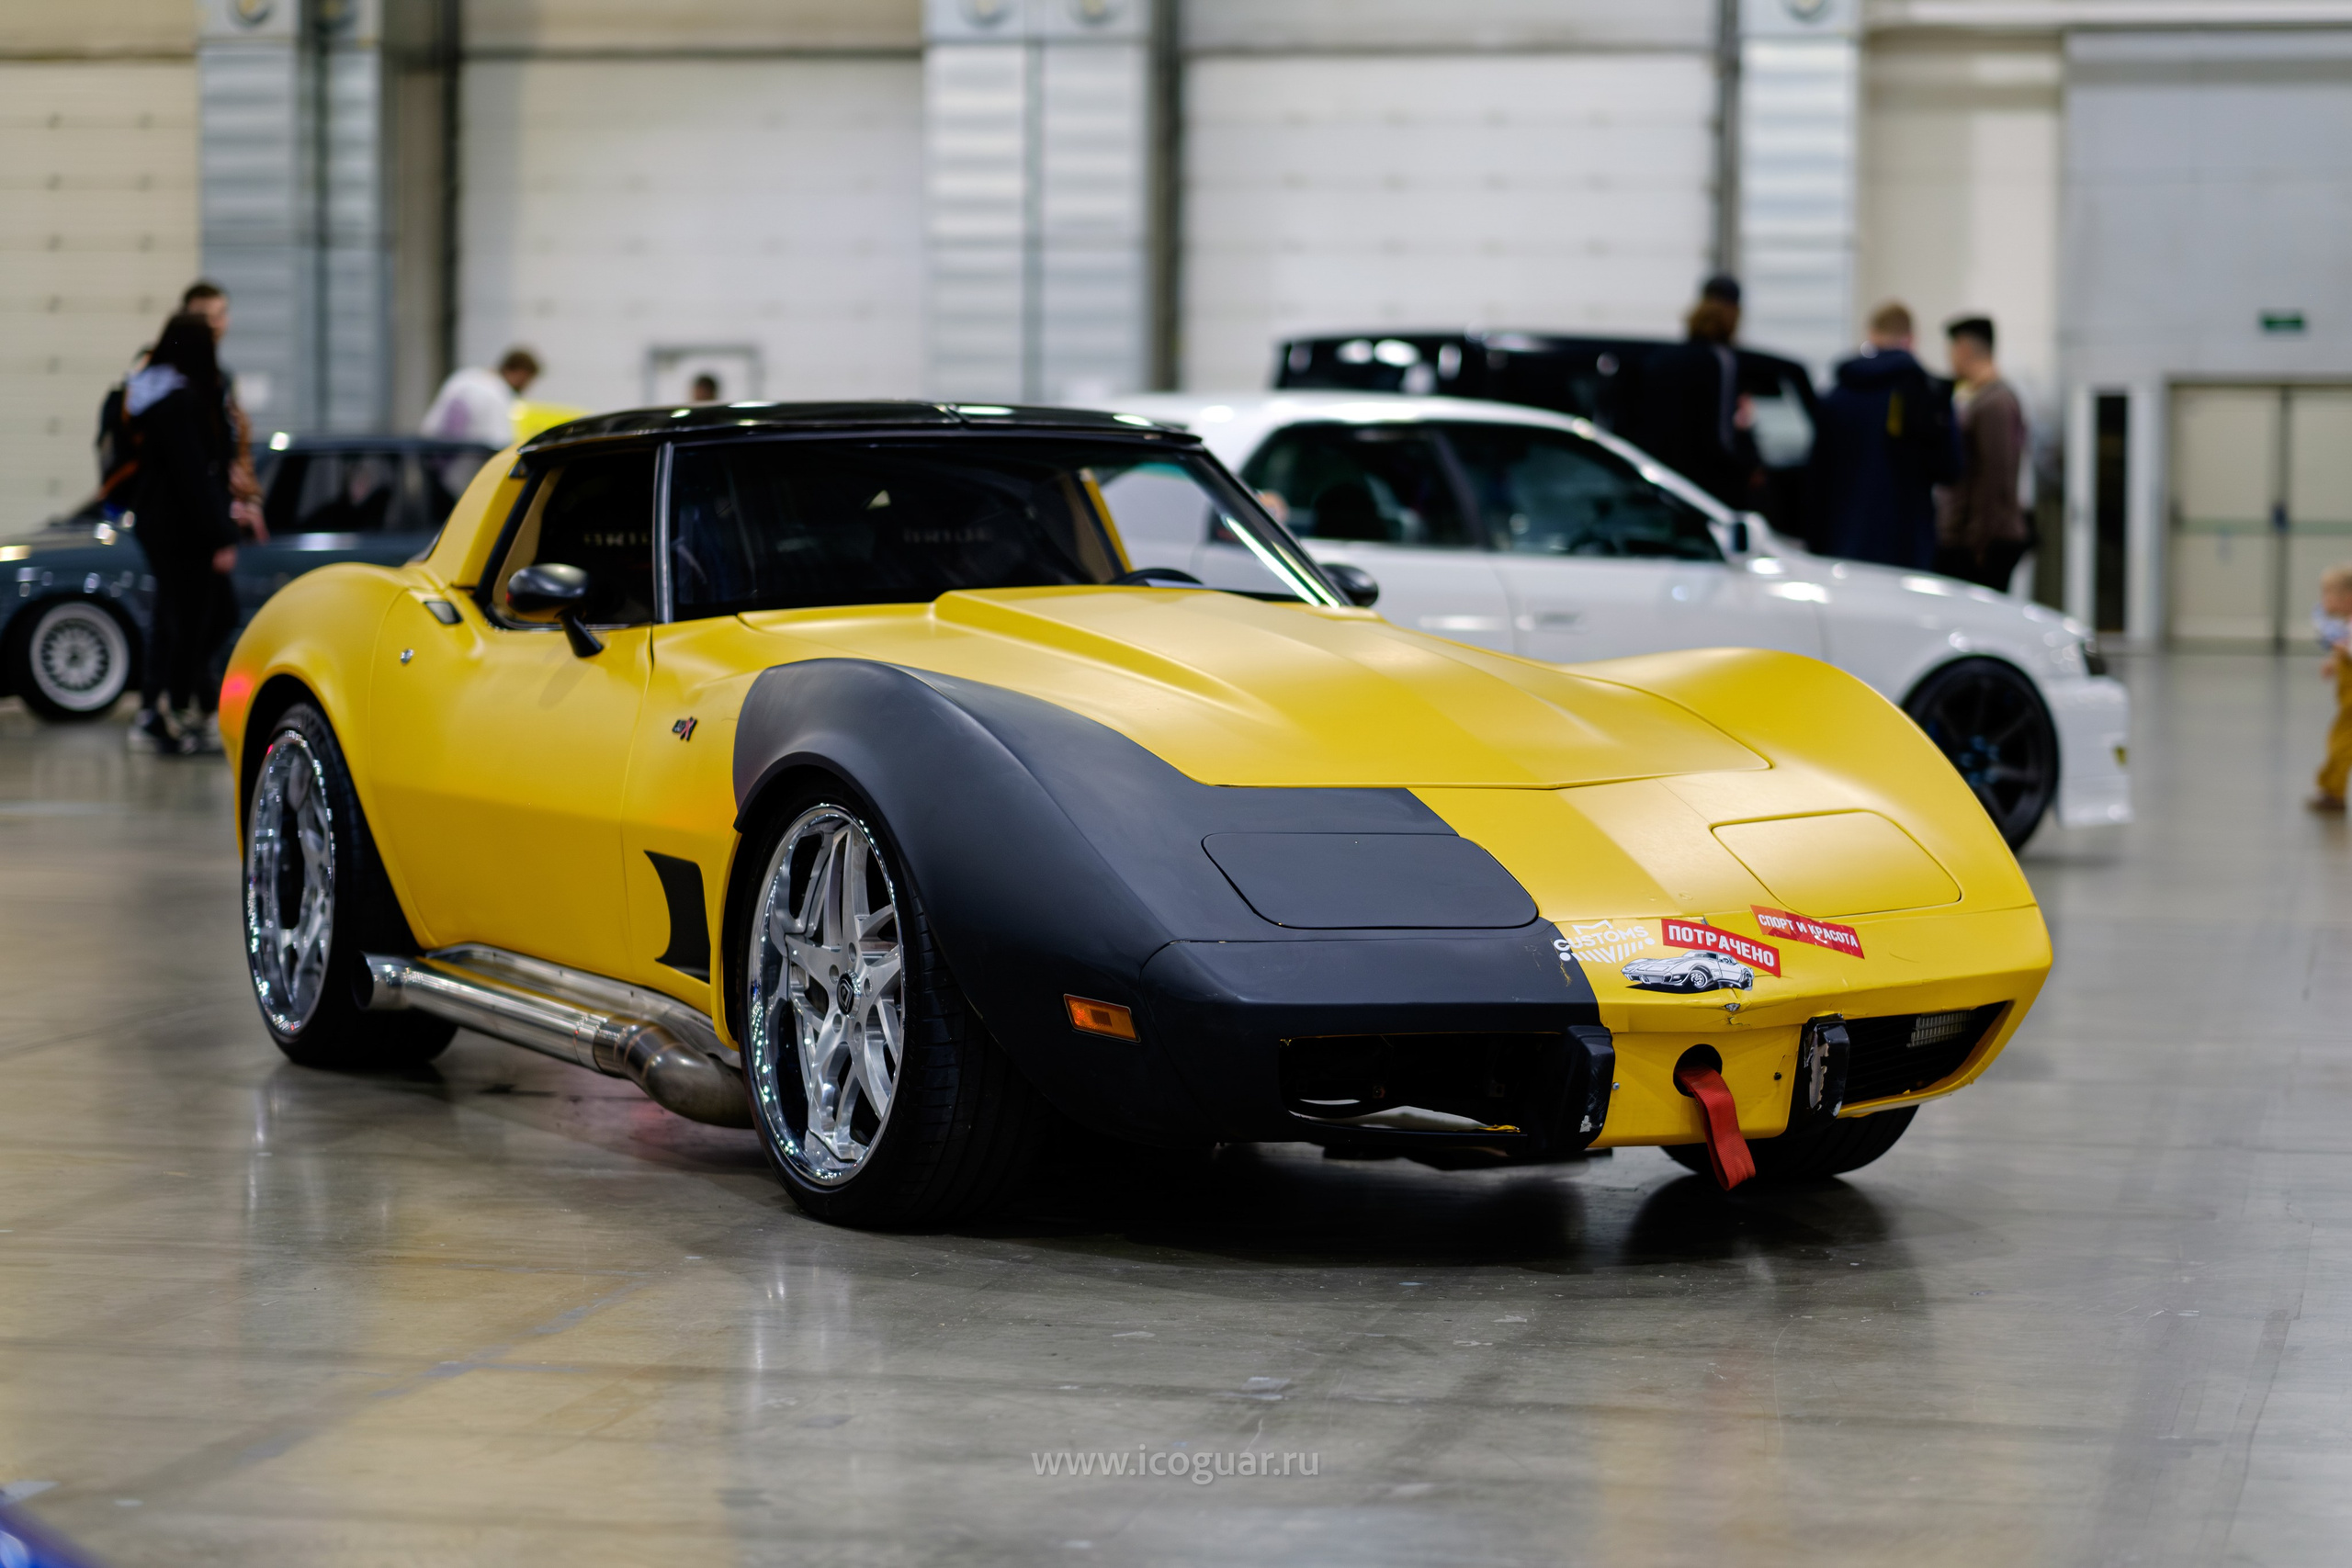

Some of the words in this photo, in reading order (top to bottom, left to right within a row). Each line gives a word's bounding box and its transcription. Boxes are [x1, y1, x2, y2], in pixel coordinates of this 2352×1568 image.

[1553, 925, 1649, 952] CUSTOMS
[1668, 924, 1775, 968] ПОТРАЧЕНО
[1757, 913, 1793, 931] СПОРТ
[1796, 920, 1808, 934] И
[1807, 923, 1860, 949] КРАСОТА
